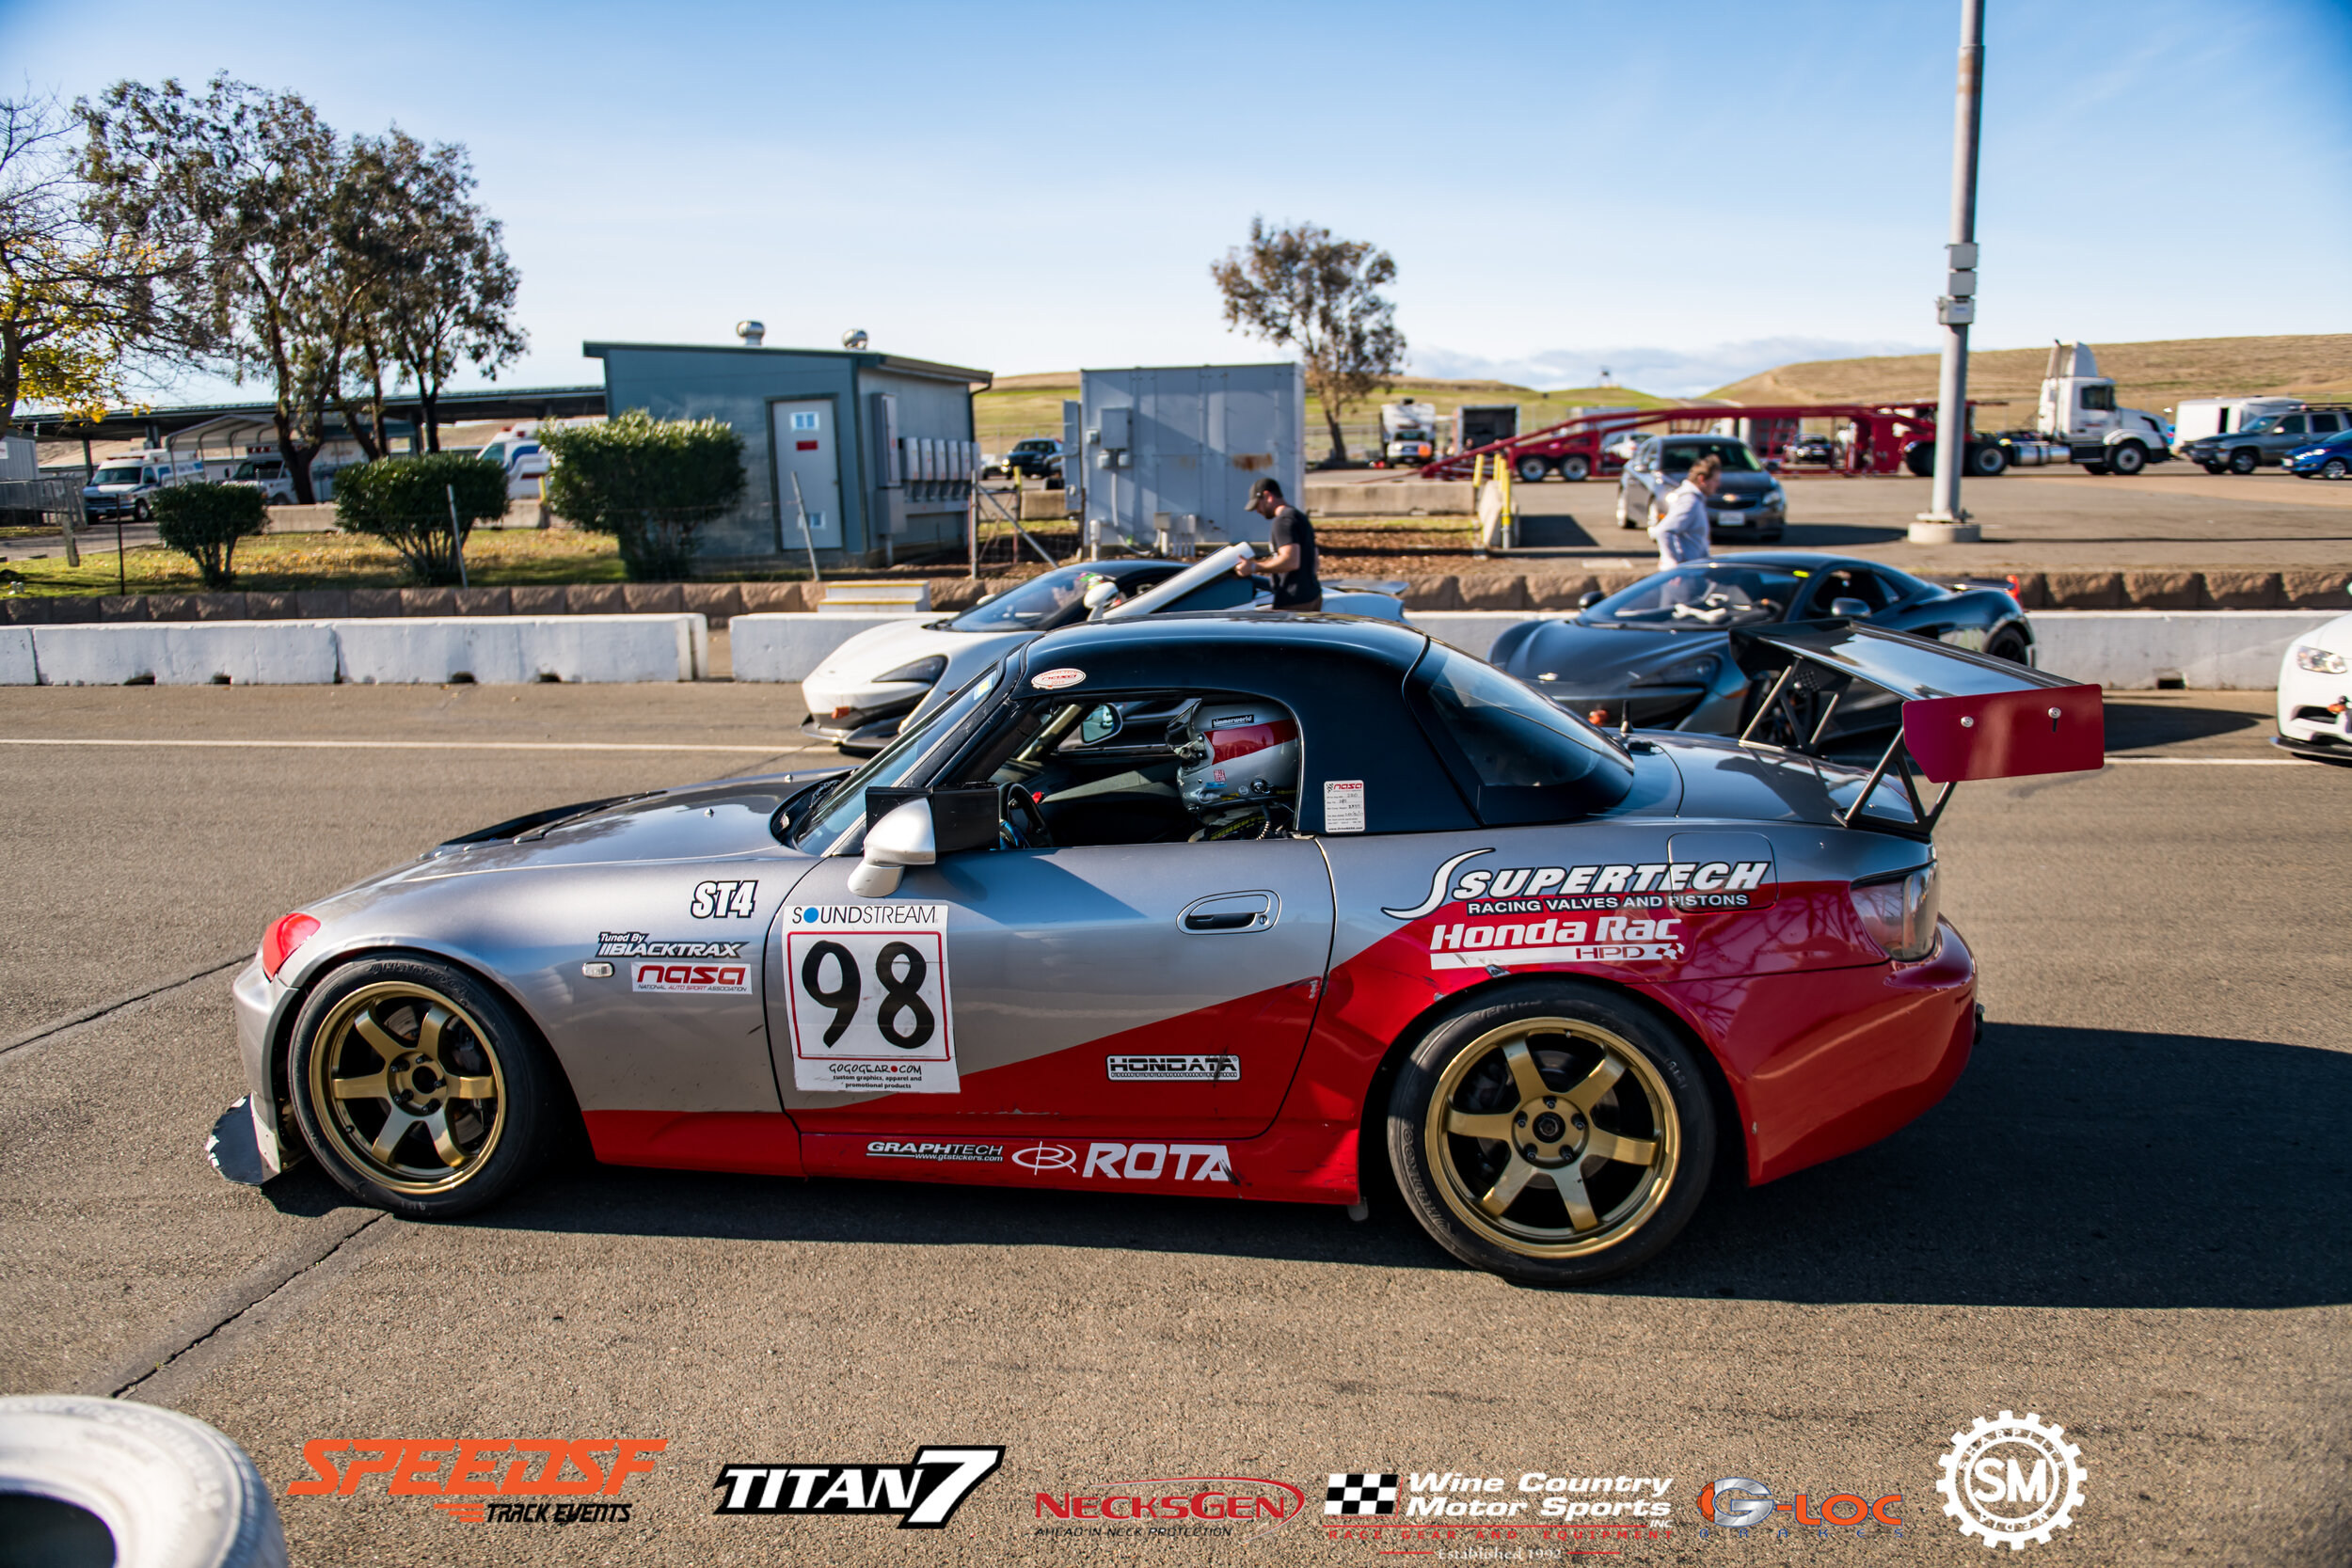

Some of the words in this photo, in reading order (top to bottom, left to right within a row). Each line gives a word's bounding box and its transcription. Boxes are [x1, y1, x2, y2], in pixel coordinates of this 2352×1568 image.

[1213, 716, 1252, 726] bimmerworld
[1452, 861, 1772, 901] SUPERTECH
[691, 880, 758, 918] ST4
[1467, 899, 1541, 915] RACING
[1547, 896, 1618, 911] VALVES
[1622, 895, 1662, 909] AND
[1668, 893, 1749, 909] PISTONS
[792, 906, 936, 924] SOUNDSTREAM
[600, 933, 629, 942] Tuned
[631, 934, 645, 943] By
[1429, 917, 1588, 951] Honda
[1594, 915, 1683, 942] Rac
[1575, 945, 1645, 960] HPD
[801, 940, 935, 1050] 98
[1109, 1057, 1238, 1072] HONDATA
[845, 1082, 883, 1090] promotional
[856, 1074, 884, 1083] graphics,
[885, 1074, 909, 1083] apparel
[866, 1141, 1004, 1156] GRAPHTECH
[914, 1153, 1004, 1164] www.gtstickers.com
[1081, 1142, 1232, 1182] ROTA
